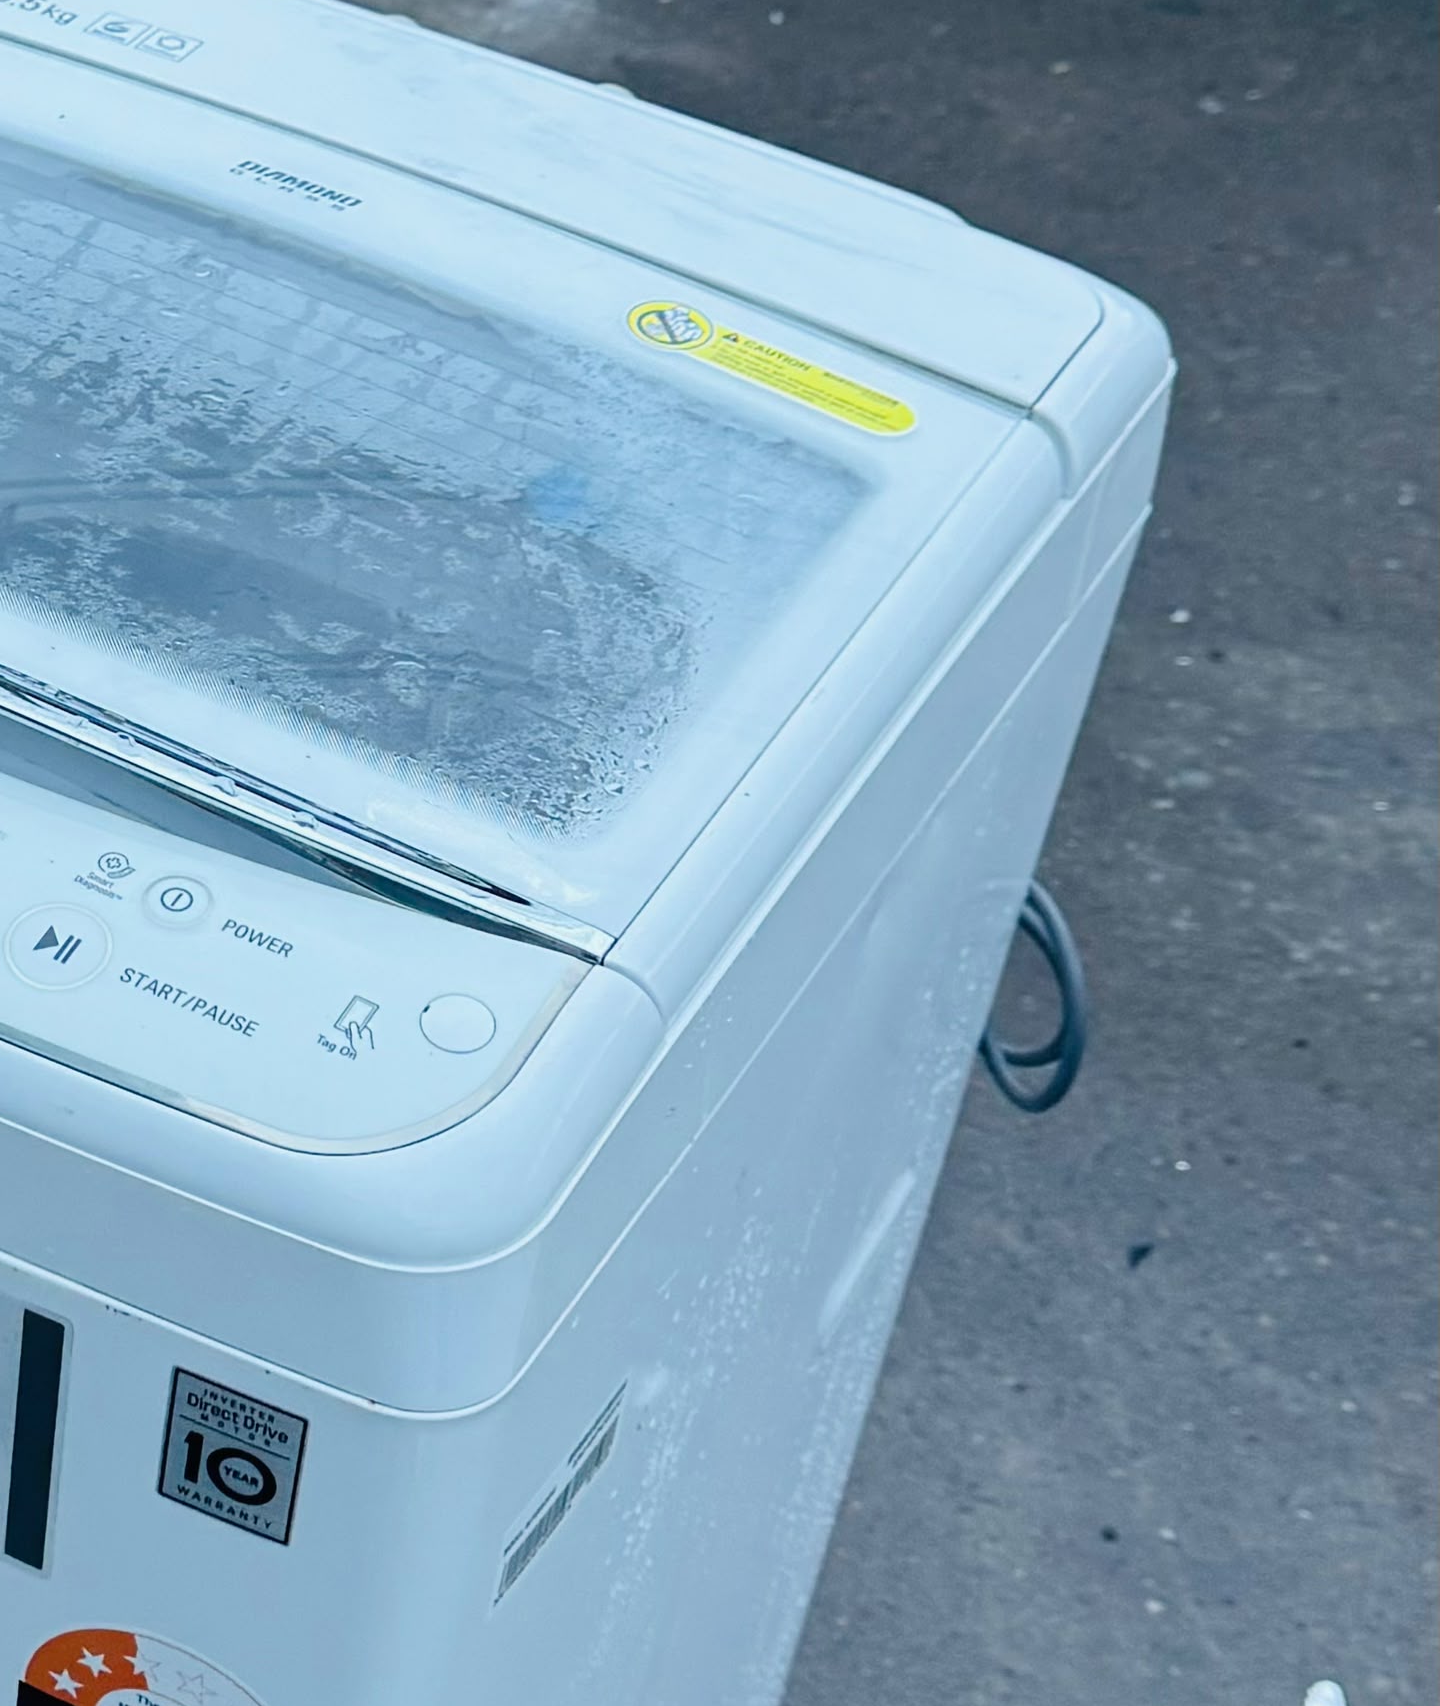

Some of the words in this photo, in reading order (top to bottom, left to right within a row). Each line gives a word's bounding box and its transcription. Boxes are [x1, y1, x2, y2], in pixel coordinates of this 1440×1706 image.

[237, 160, 363, 207] DIAMOND
[744, 340, 811, 372] CAUTION
[86, 871, 114, 888] Smart
[221, 917, 294, 959] POWER
[119, 967, 260, 1038] START/PAUSE
[316, 1033, 338, 1056] Tag
[338, 1045, 359, 1062] On
[187, 1392, 240, 1425] Direct
[243, 1415, 289, 1444] Drive
[203, 1389, 276, 1424] INVERTER
[200, 1413, 272, 1447] MOTOR
[184, 1430, 277, 1506] 10
[224, 1465, 259, 1487] YEAR
[177, 1484, 272, 1529] WARRANTY
